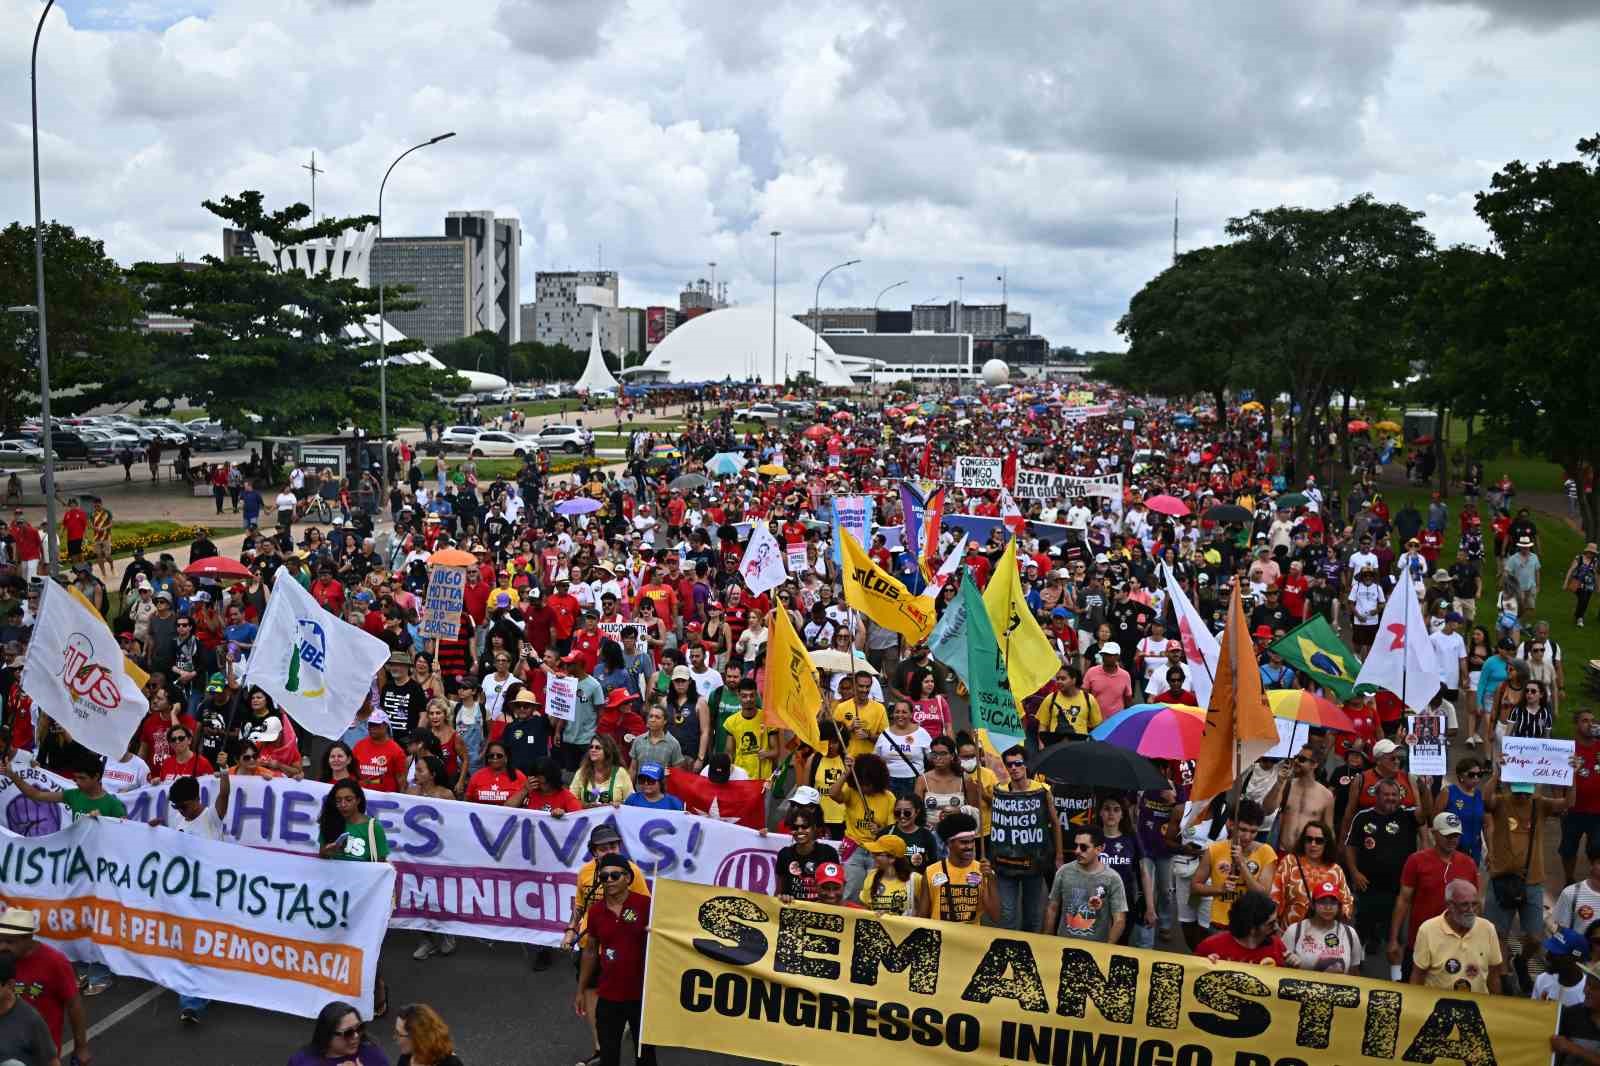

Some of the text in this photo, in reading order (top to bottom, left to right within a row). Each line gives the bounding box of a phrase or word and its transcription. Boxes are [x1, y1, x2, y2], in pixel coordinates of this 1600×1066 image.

[1018, 472, 1049, 487] SEM
[1017, 486, 1035, 497] PRA
[889, 744, 911, 752] FRA
[992, 798, 1041, 812] CONGRESSO
[991, 827, 1043, 845] DO POVO
[97, 857, 132, 890] PRA
[137, 850, 350, 930] GOLPISTAS!
[131, 915, 183, 951] PELA
[193, 927, 351, 985] DEMOCRACIA
[692, 895, 1499, 1066] SEM ANISTIA
[680, 968, 980, 1053] CONGRESSO
